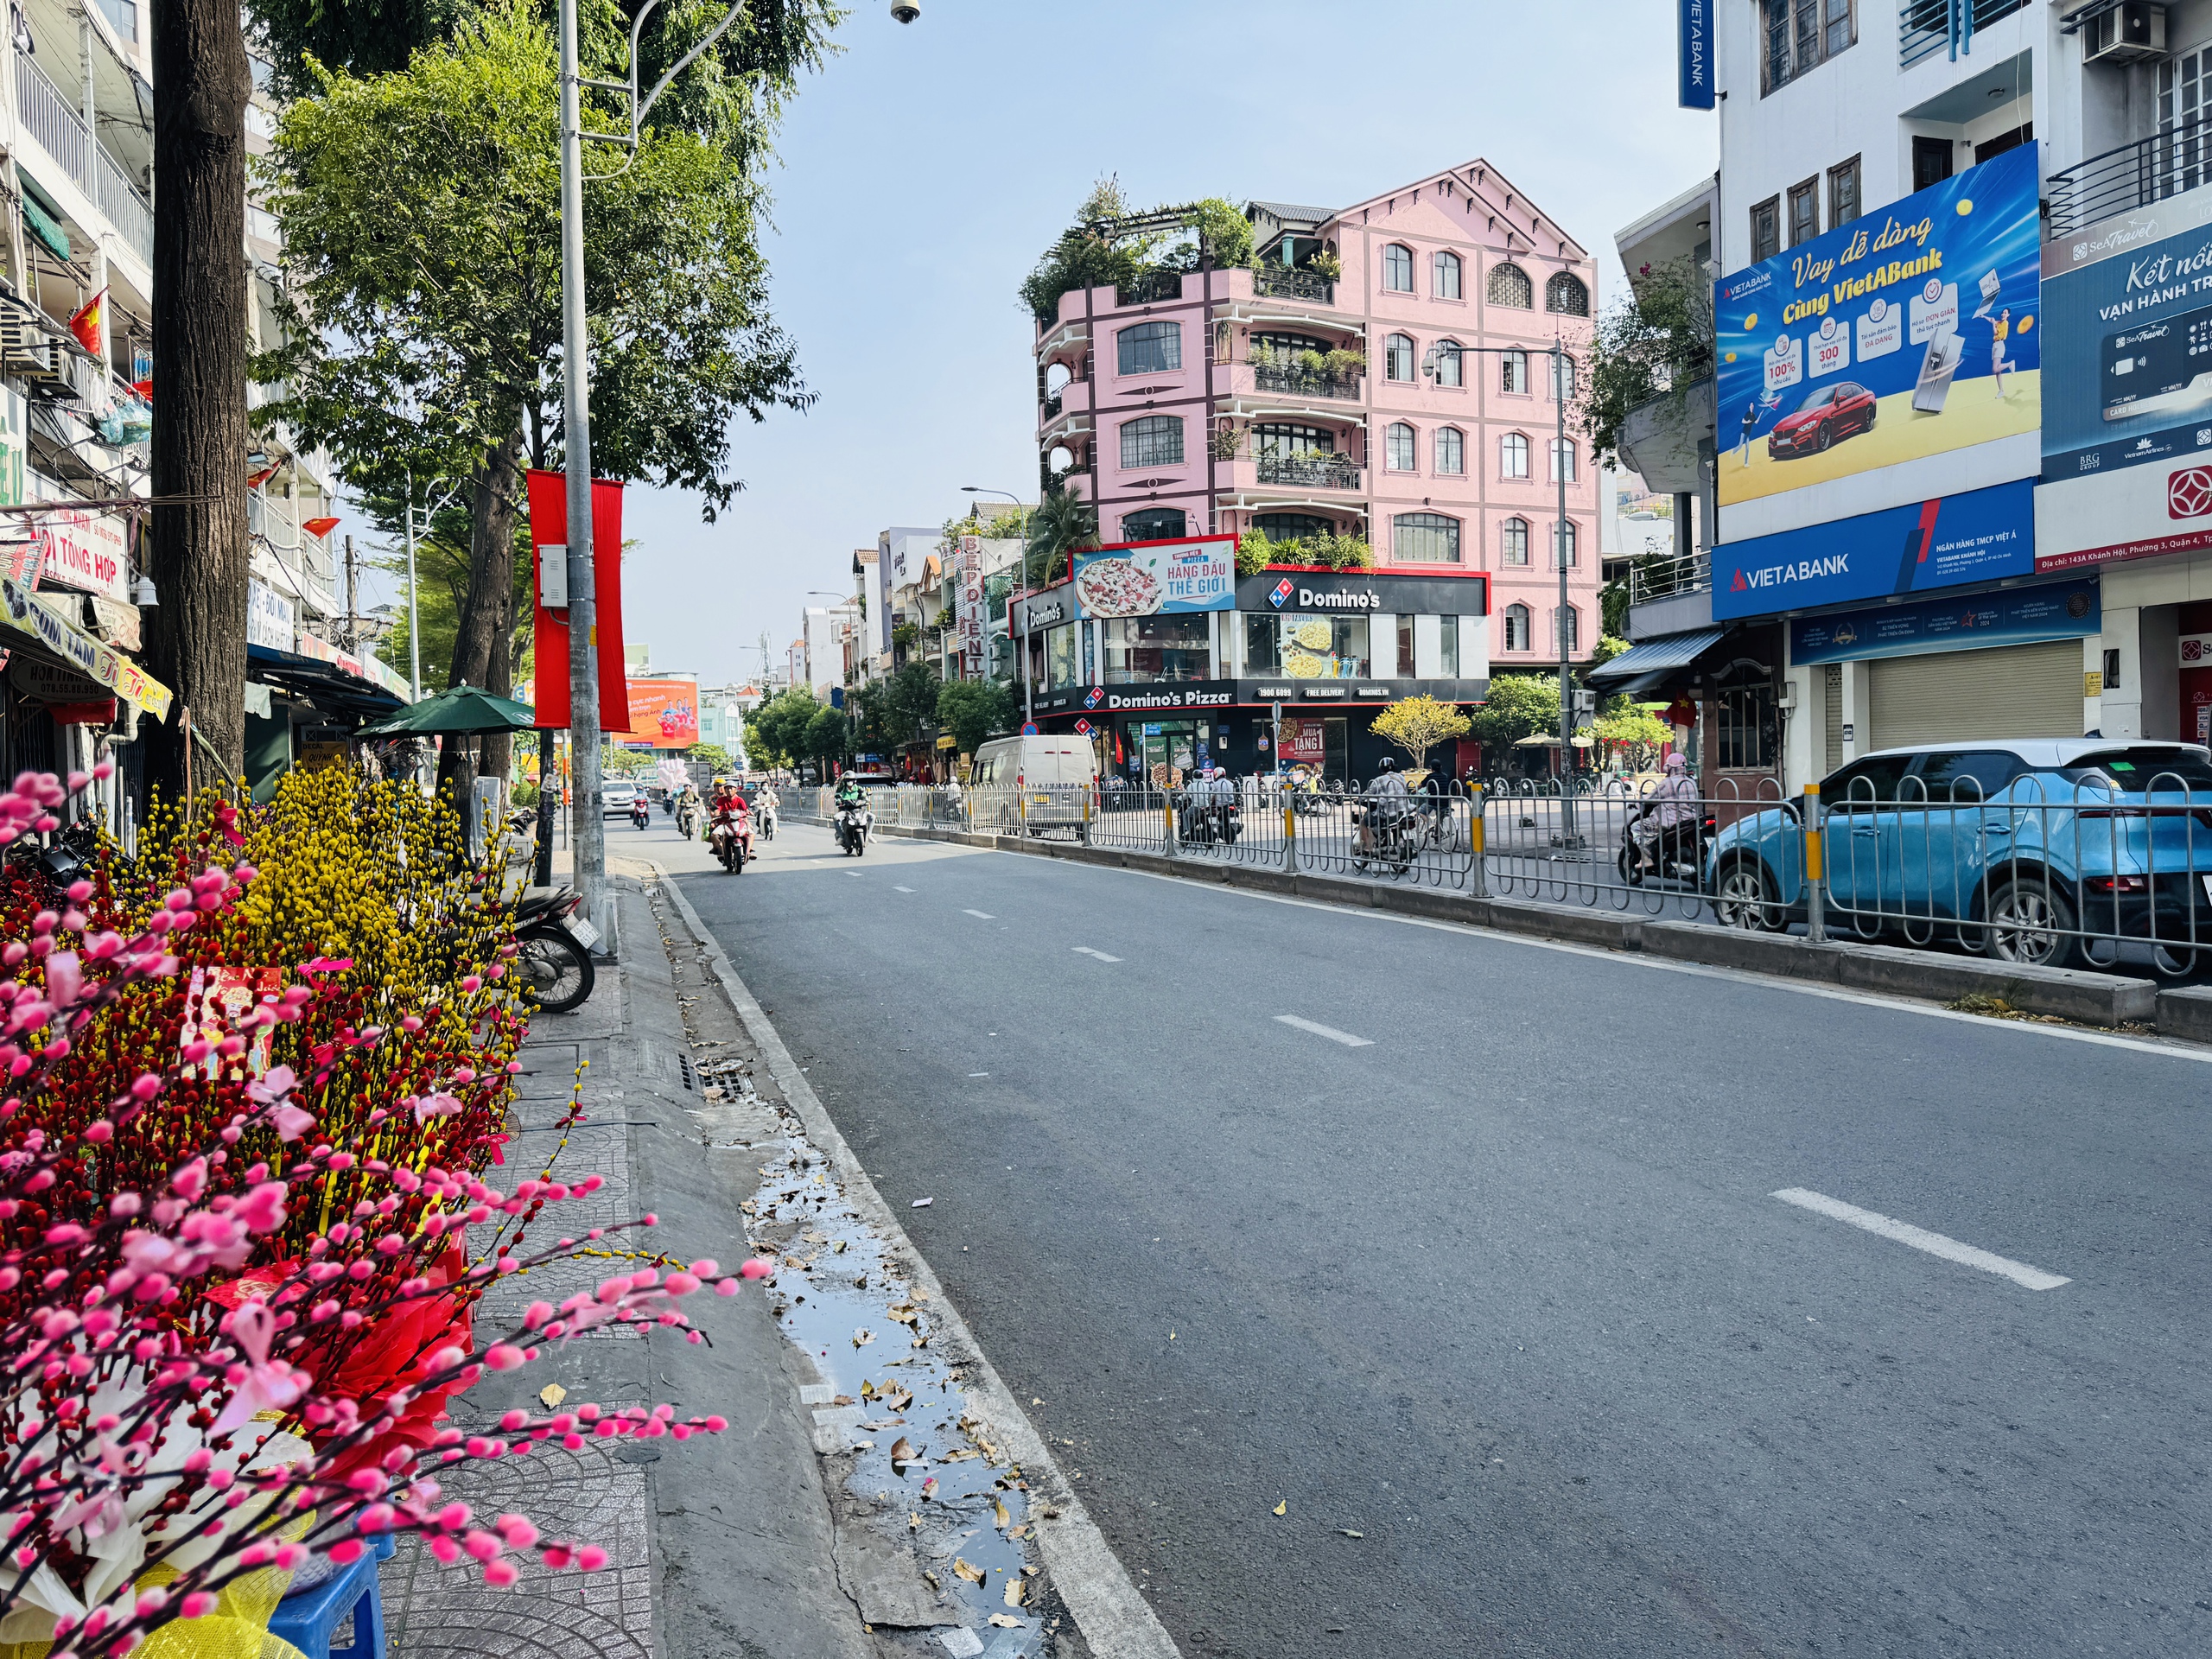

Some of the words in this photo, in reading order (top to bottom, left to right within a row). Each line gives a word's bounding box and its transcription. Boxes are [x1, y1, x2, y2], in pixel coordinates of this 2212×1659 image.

[1691, 0, 1702, 86] IETABANK
[1792, 252, 1835, 289] Vay
[1840, 230, 1869, 265] dễ
[1872, 216, 1934, 252] dàng
[2126, 254, 2172, 293] Kết
[2176, 242, 2212, 276] nối
[1730, 271, 1771, 296] VIETABANK
[1783, 292, 1829, 325] Cùng
[1834, 247, 1942, 304] VietABank
[2099, 300, 2133, 321] VẠN
[2138, 283, 2186, 309] HÀNH
[1934, 318, 1950, 327] nhanh
[1819, 346, 1839, 362] 300
[1770, 361, 1796, 379] 100%
[2109, 408, 2126, 417] CARD
[2080, 453, 2100, 464] BRG
[1936, 543, 1955, 553] NGÂN
[1955, 538, 1974, 550] HÀNG
[1976, 535, 1994, 545] TMCP
[1995, 531, 2009, 543] VIỆT
[2011, 529, 2017, 539] Á
[60, 528, 91, 576] TỔNG
[94, 553, 117, 588] HỢP
[1936, 554, 1960, 563] VIETABANK
[2042, 561, 2053, 569] Địa
[2054, 557, 2067, 567] chỉ:
[2069, 555, 2087, 564] 143A
[2088, 550, 2111, 561] Khánh
[2113, 548, 2127, 557] Hội,
[2129, 543, 2158, 555] Phường
[2160, 542, 2168, 550] 3,
[2170, 538, 2190, 550] Quận
[2192, 537, 2200, 545] 4,
[1167, 563, 1198, 579] HÀNG
[1202, 559, 1225, 576] ĐẦU
[1746, 553, 1849, 588] VIETABANK
[1167, 575, 1192, 595] THẾ
[1198, 575, 1225, 594] GIỚI
[1299, 588, 1380, 607] Domino's
[1030, 603, 1061, 627] Domino's
[66, 630, 96, 670] TẤM
[99, 651, 120, 688] Ti
[124, 667, 147, 702] Ti
[41, 683, 99, 695] 078.55.88.950
[645, 694, 665, 702] nhanh
[1109, 690, 1181, 709] Domino's
[1185, 690, 1230, 705] Pizza
[1294, 735, 1317, 751] TẶNG
[1317, 728, 1323, 750] 1
[1302, 728, 1317, 737] MUA
